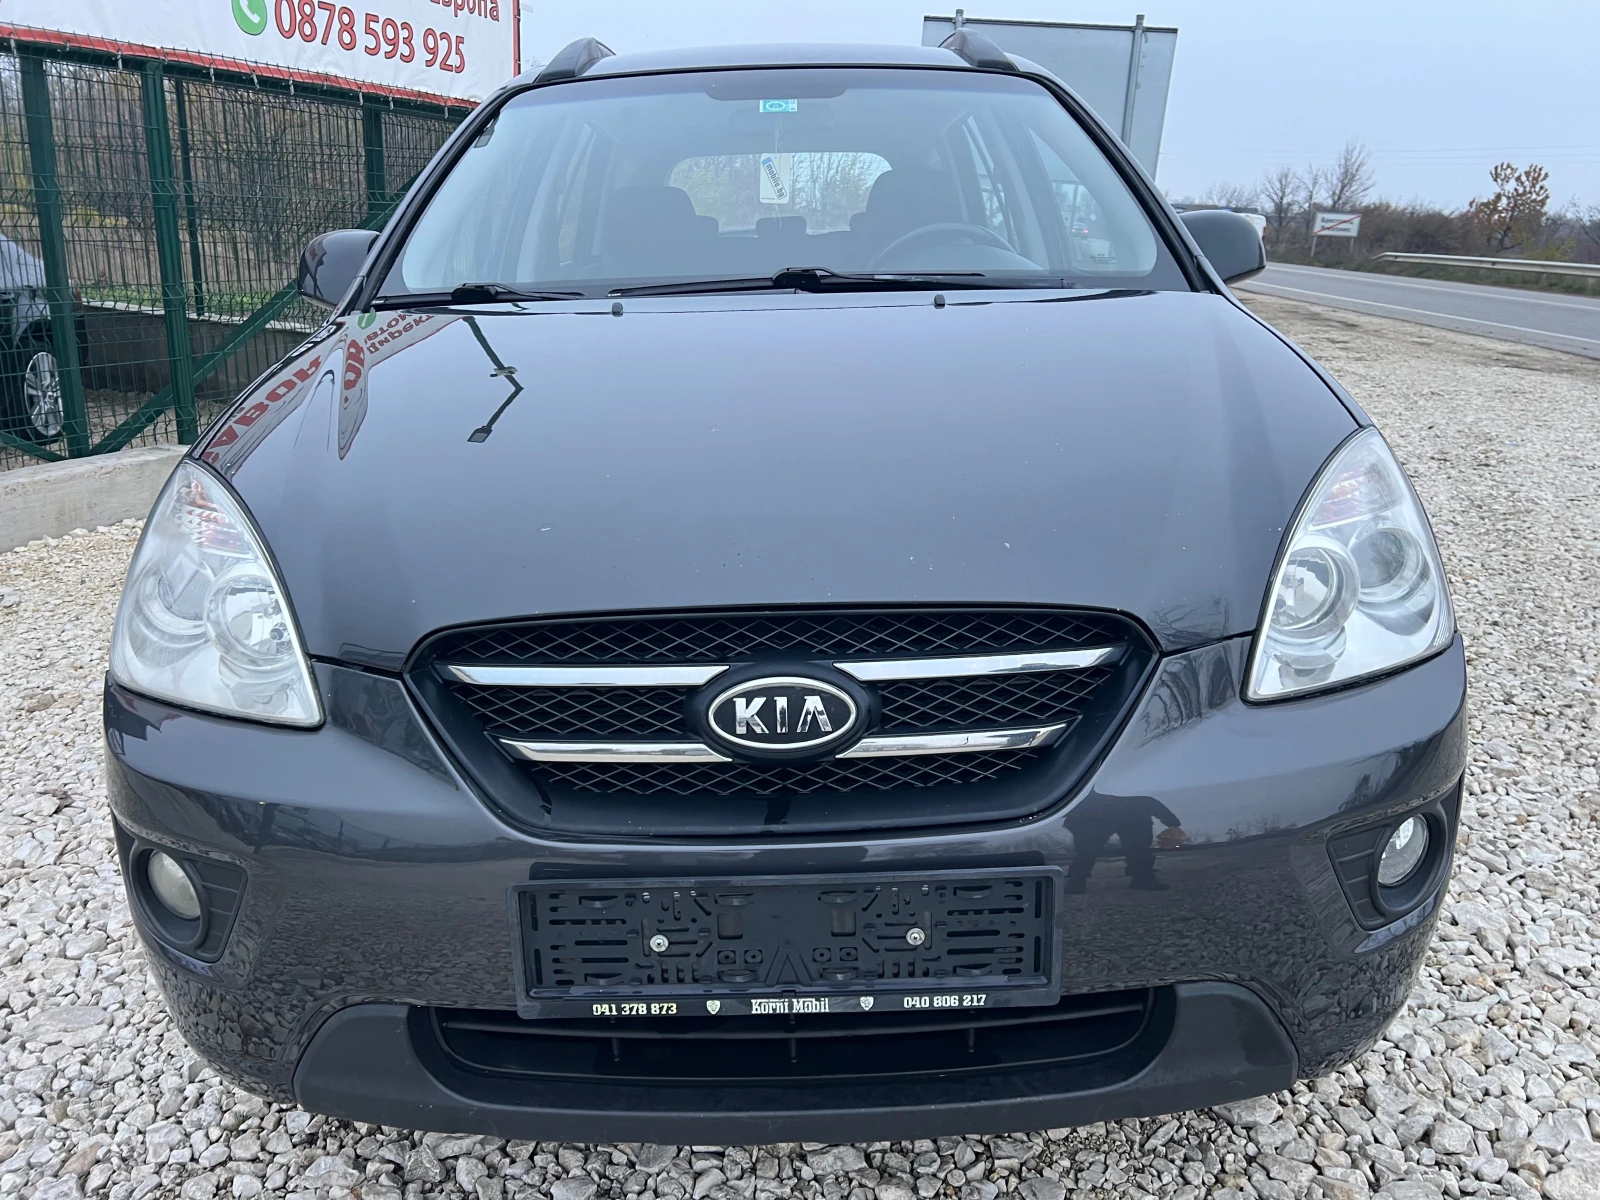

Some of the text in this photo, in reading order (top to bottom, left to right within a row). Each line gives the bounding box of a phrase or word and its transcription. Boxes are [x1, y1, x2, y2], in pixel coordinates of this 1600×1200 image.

[275, 0, 466, 74] 0878 593 925
[766, 163, 786, 198] mobile.bg
[733, 695, 833, 735] KIA
[592, 1002, 678, 1017] 041 378 873
[792, 997, 830, 1014] Mobil
[903, 994, 987, 1010] 040 806 217
